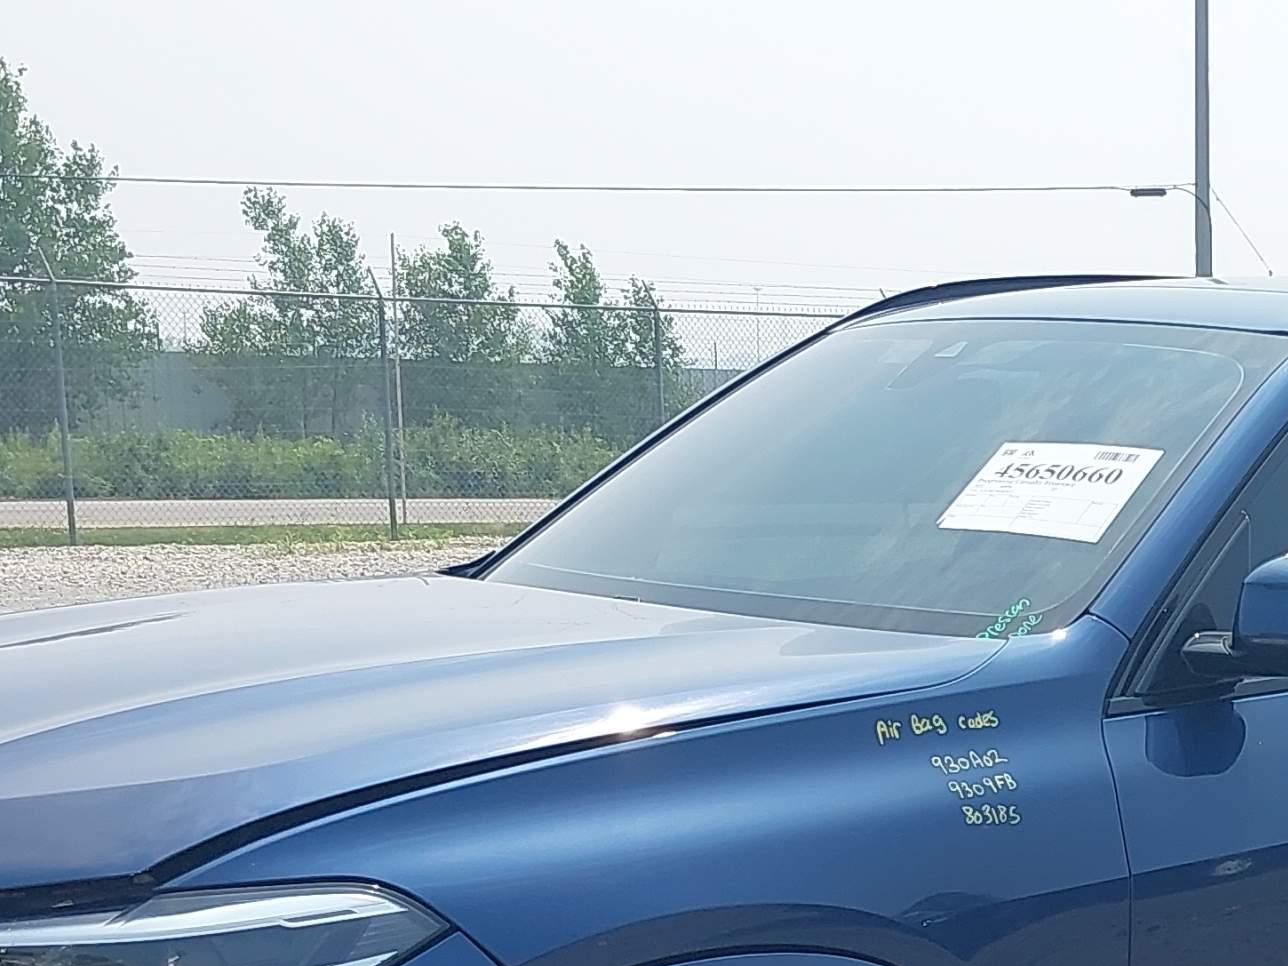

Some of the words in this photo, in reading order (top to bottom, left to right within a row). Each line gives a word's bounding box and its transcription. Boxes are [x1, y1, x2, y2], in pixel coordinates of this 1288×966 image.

[994, 461, 1124, 486] 45650660
[876, 719, 902, 746] Air
[910, 713, 948, 736] Bag
[930, 748, 1009, 775] 930A02
